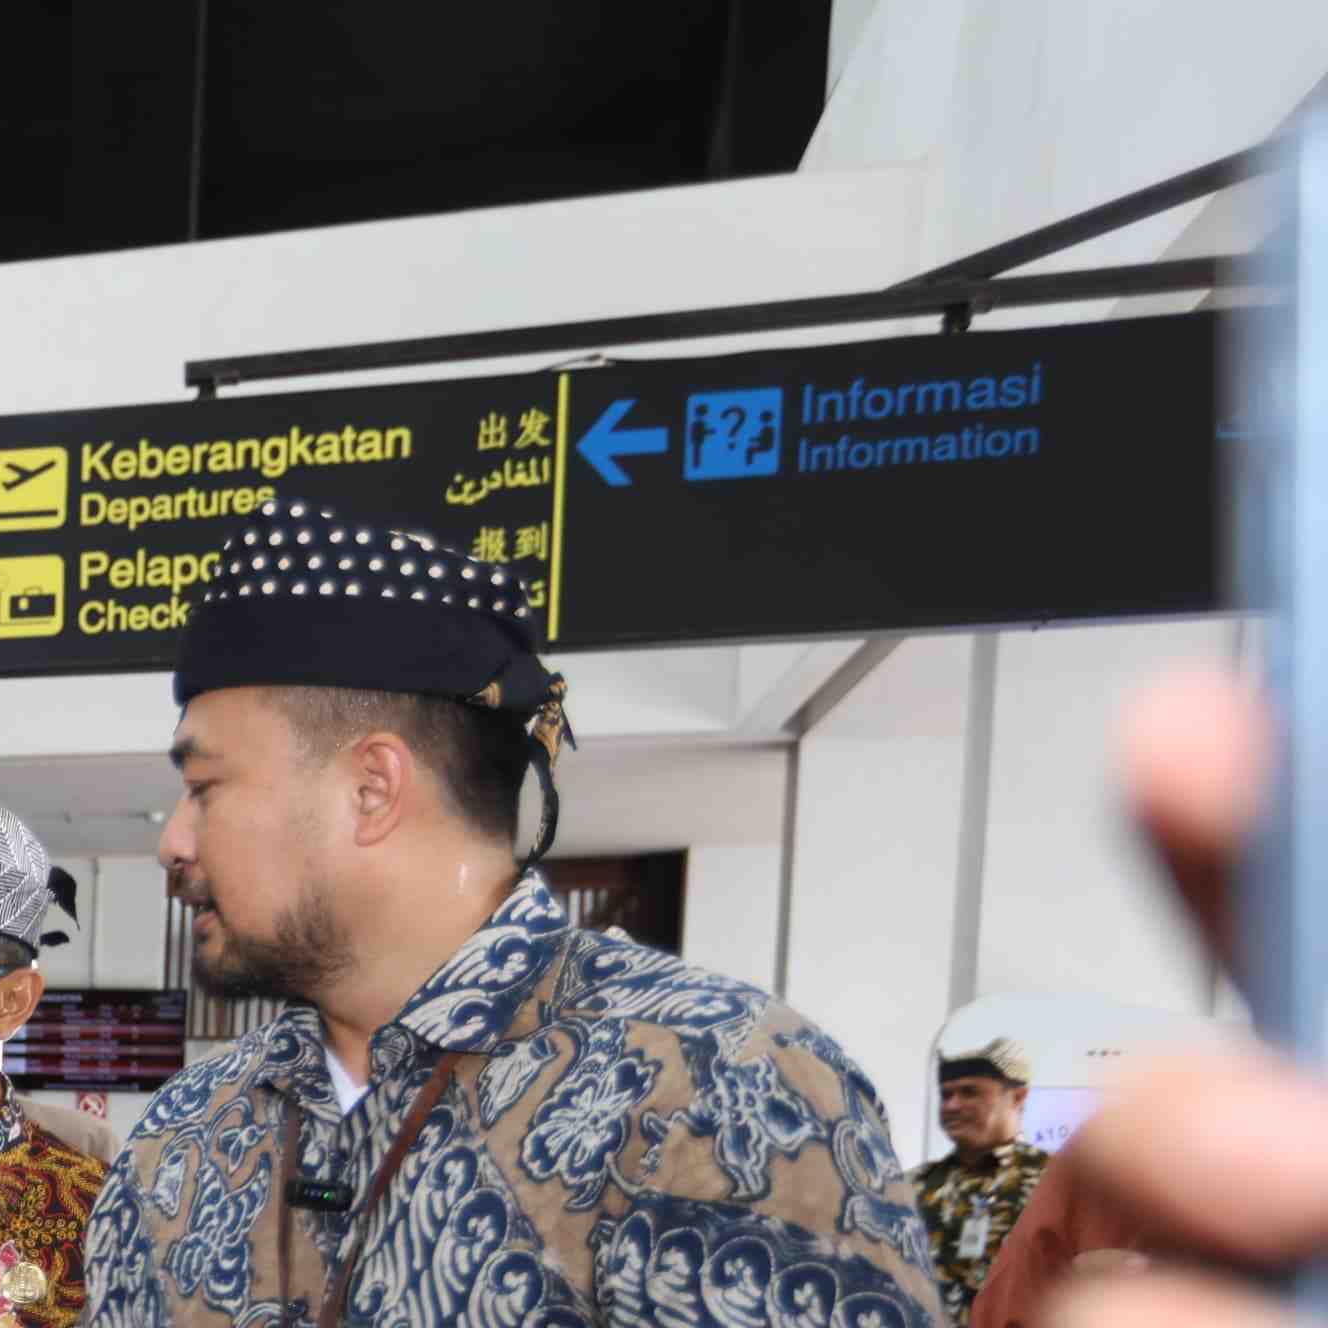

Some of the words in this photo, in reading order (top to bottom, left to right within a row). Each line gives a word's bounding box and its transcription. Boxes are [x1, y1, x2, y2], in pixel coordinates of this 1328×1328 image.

[801, 360, 1042, 426] Informasi
[79, 425, 413, 481] Keberangkatan
[478, 409, 550, 450] 出发
[798, 423, 1041, 472] Information
[79, 485, 275, 530] Departures
